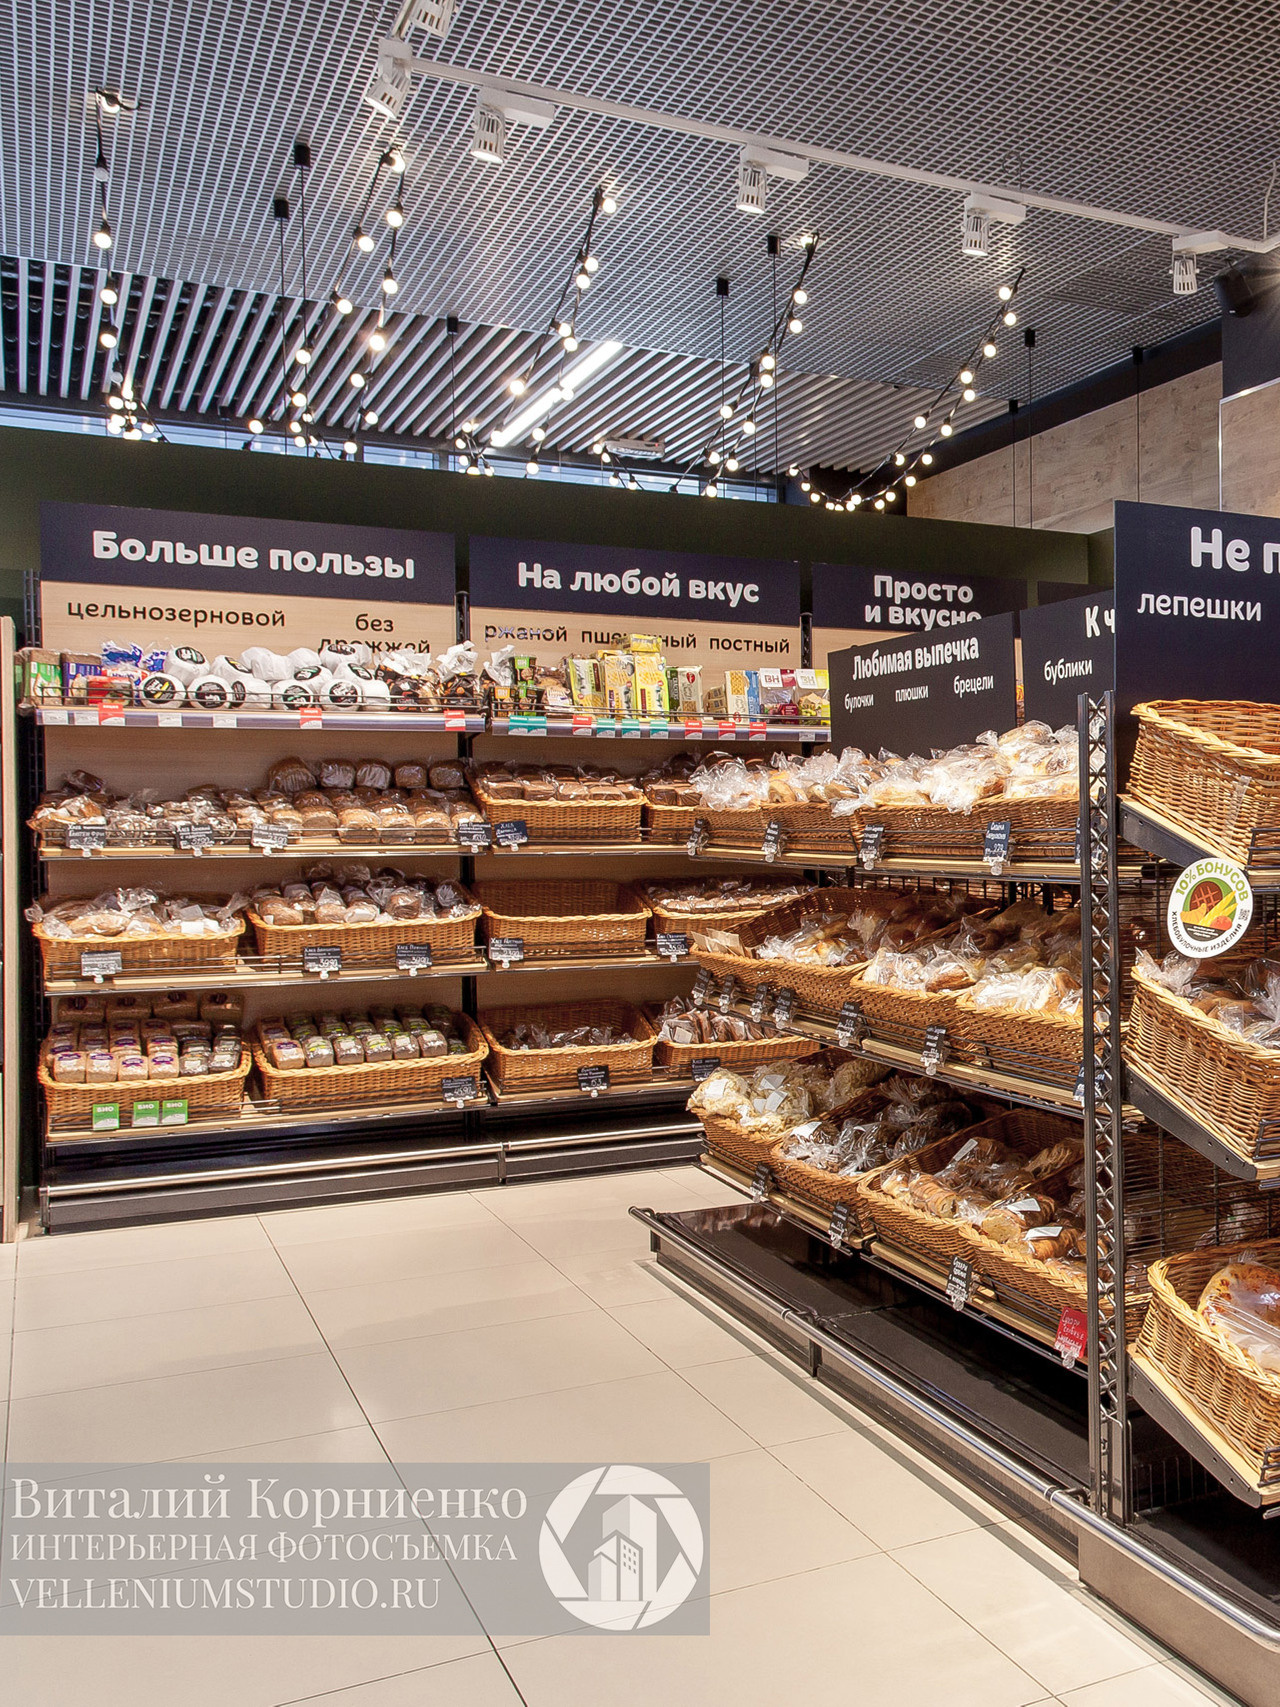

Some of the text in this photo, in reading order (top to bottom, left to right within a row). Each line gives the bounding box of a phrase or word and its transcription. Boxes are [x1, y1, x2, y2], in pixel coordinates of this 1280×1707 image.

[92, 530, 415, 580] Больше пользы
[1190, 526, 1251, 571] Не
[518, 562, 760, 607] На любой вкус
[873, 574, 973, 604] Просто
[67, 601, 286, 628] цельнозерновой
[864, 604, 881, 624] и
[1085, 605, 1101, 638] К
[1137, 591, 1262, 622] лепешки
[355, 613, 394, 633] без
[484, 625, 568, 643] ржаной
[709, 634, 791, 655] постный
[852, 637, 979, 681] Любимая выпечка
[1044, 658, 1093, 685] бублики
[844, 674, 994, 714] булочки плюшки брецели
[1196, 861, 1249, 902] БОНУСОВ
